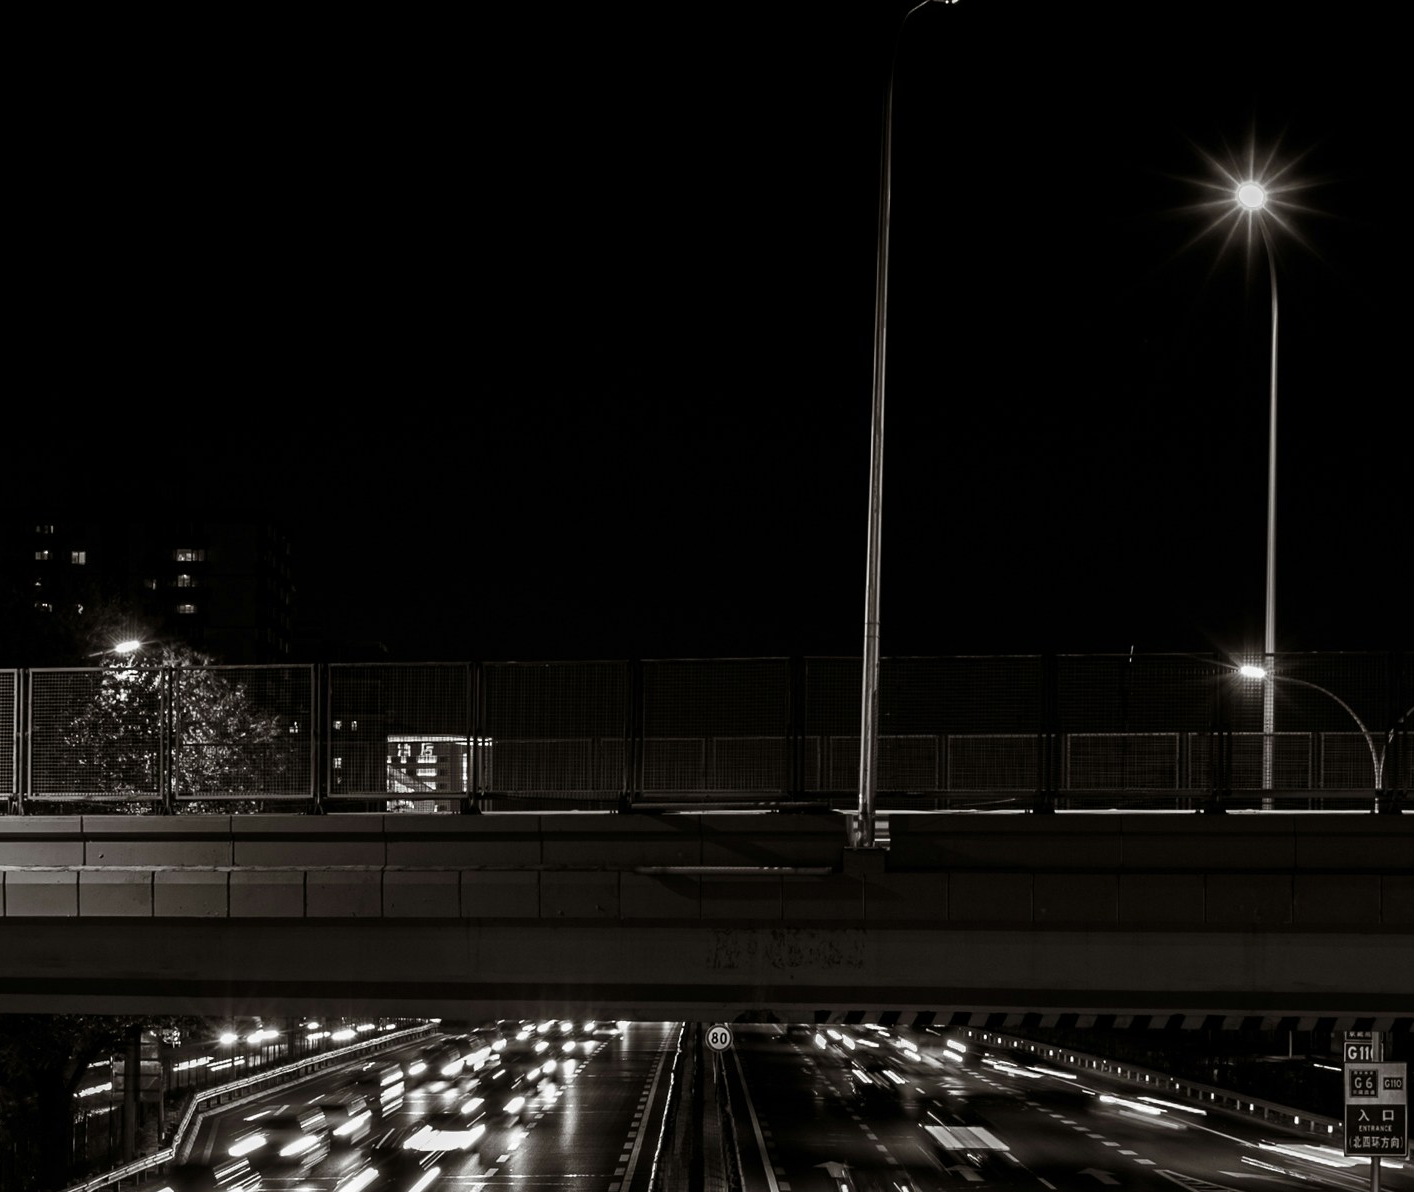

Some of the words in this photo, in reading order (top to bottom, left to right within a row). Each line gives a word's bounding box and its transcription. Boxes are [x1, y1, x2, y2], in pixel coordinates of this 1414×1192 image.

[712, 1032, 727, 1044] 80
[1384, 1079, 1402, 1088] G110
[1358, 1109, 1394, 1121] 入口
